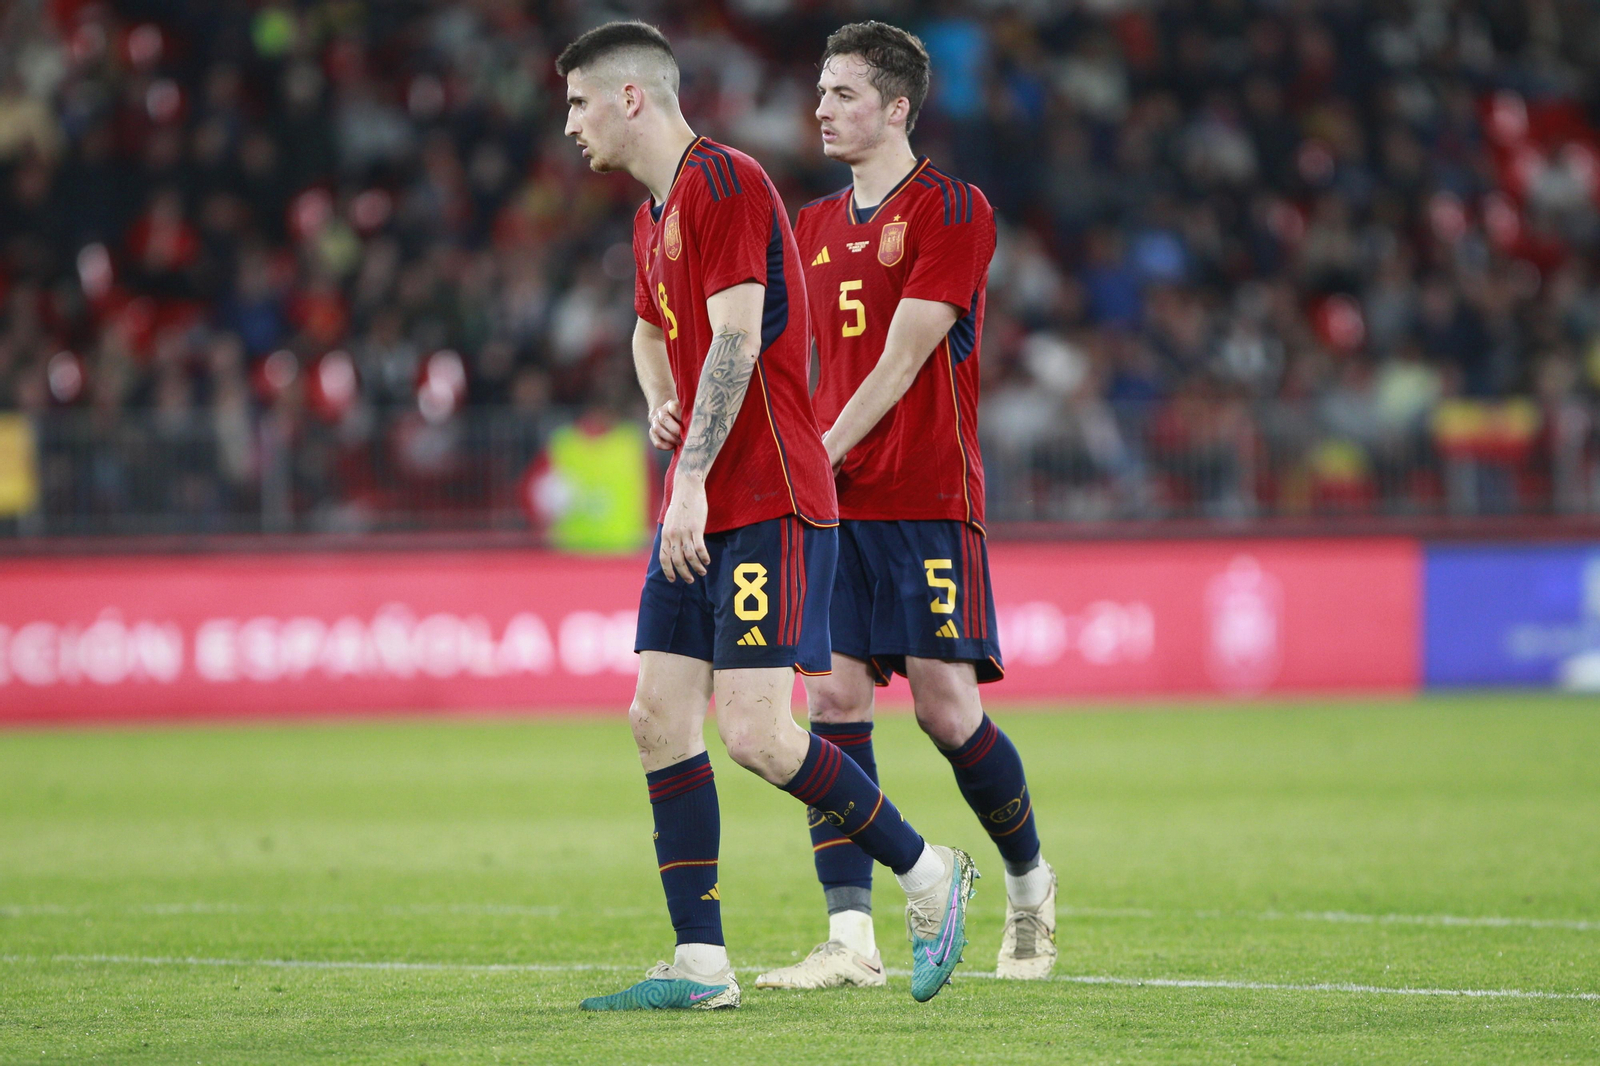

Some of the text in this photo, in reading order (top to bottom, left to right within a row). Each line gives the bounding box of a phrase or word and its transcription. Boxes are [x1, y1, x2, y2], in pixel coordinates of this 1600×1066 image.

[657, 281, 678, 341] 8
[838, 279, 867, 338] 5
[733, 562, 769, 621] 8
[923, 558, 957, 614] 5
[0, 606, 183, 685] CIÓN
[194, 602, 556, 682] ESPAÑOLA
